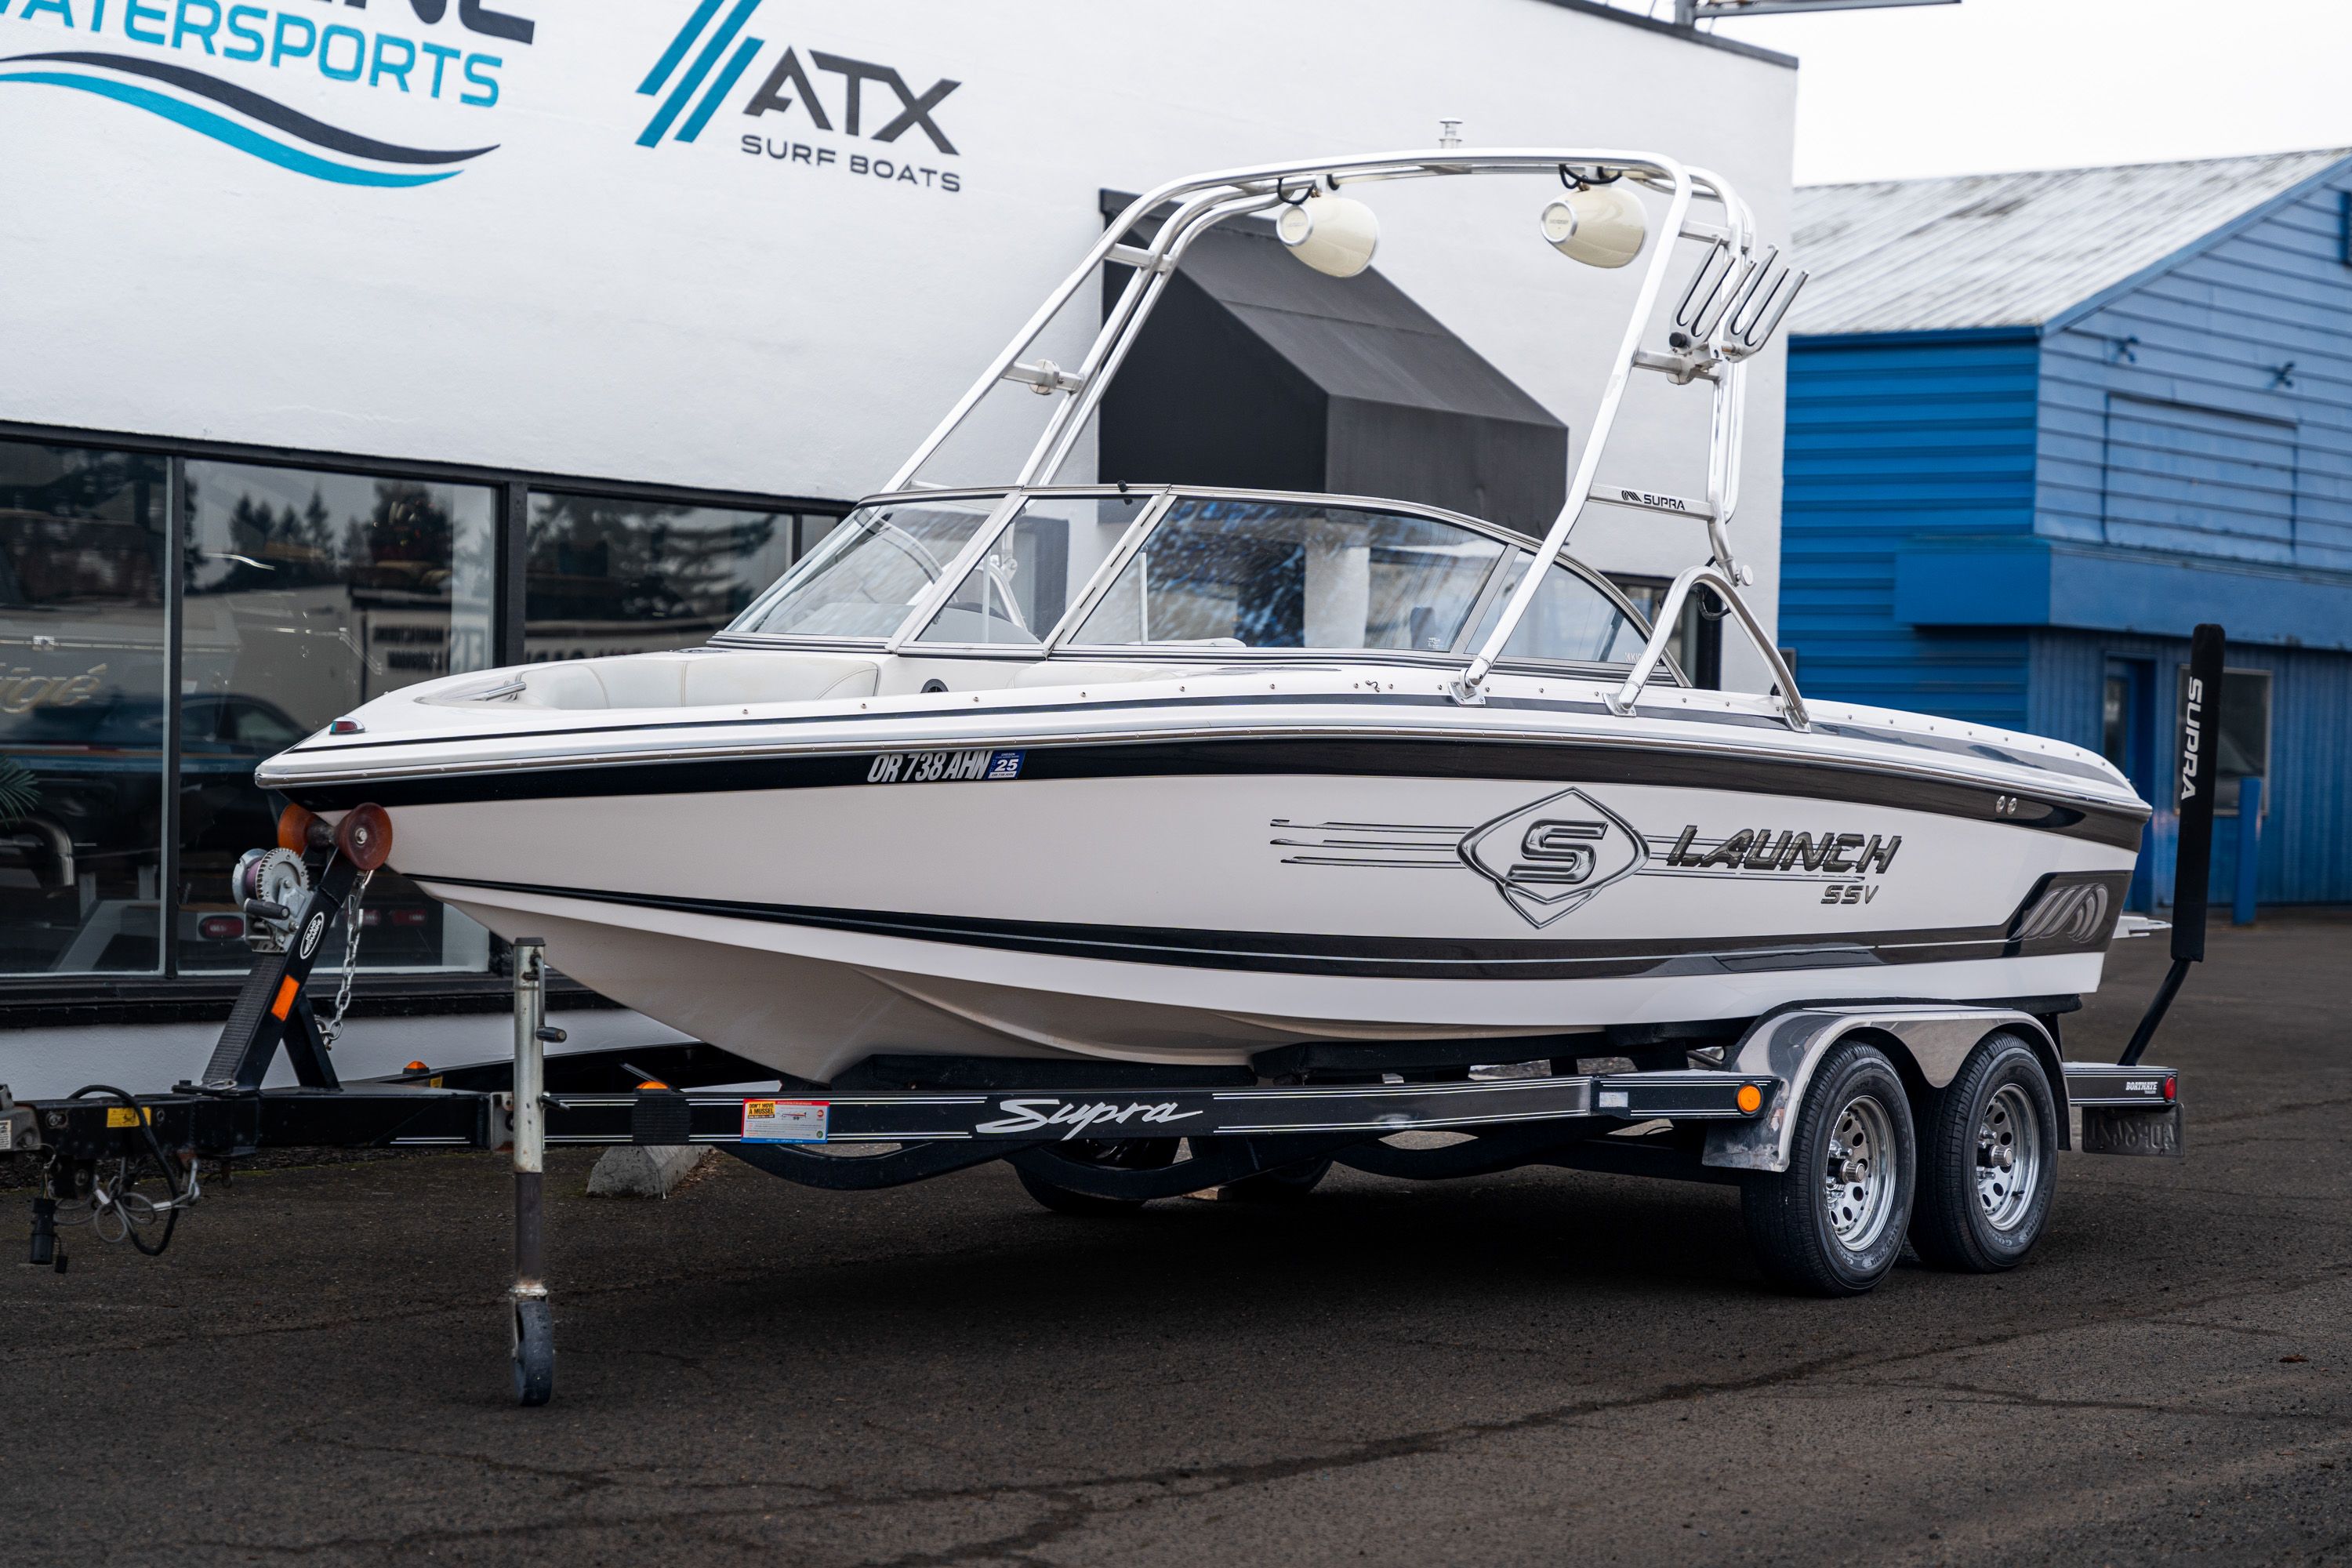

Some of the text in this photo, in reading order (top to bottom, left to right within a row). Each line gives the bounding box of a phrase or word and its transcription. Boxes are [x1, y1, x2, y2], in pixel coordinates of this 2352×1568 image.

[0, 0, 503, 107] ATERSPORTS
[742, 45, 962, 156] ATX
[741, 135, 961, 192] SURF BOATS
[1643, 493, 1686, 511] SUPRA
[0, 662, 107, 713] igé
[2181, 677, 2203, 800] SUPRA
[867, 750, 994, 783] OR 738 AHN
[994, 758, 1019, 771] 25
[1667, 825, 1902, 874] LAUNCH
[1820, 885, 1879, 905] SSV
[976, 1098, 1203, 1142] Supra
